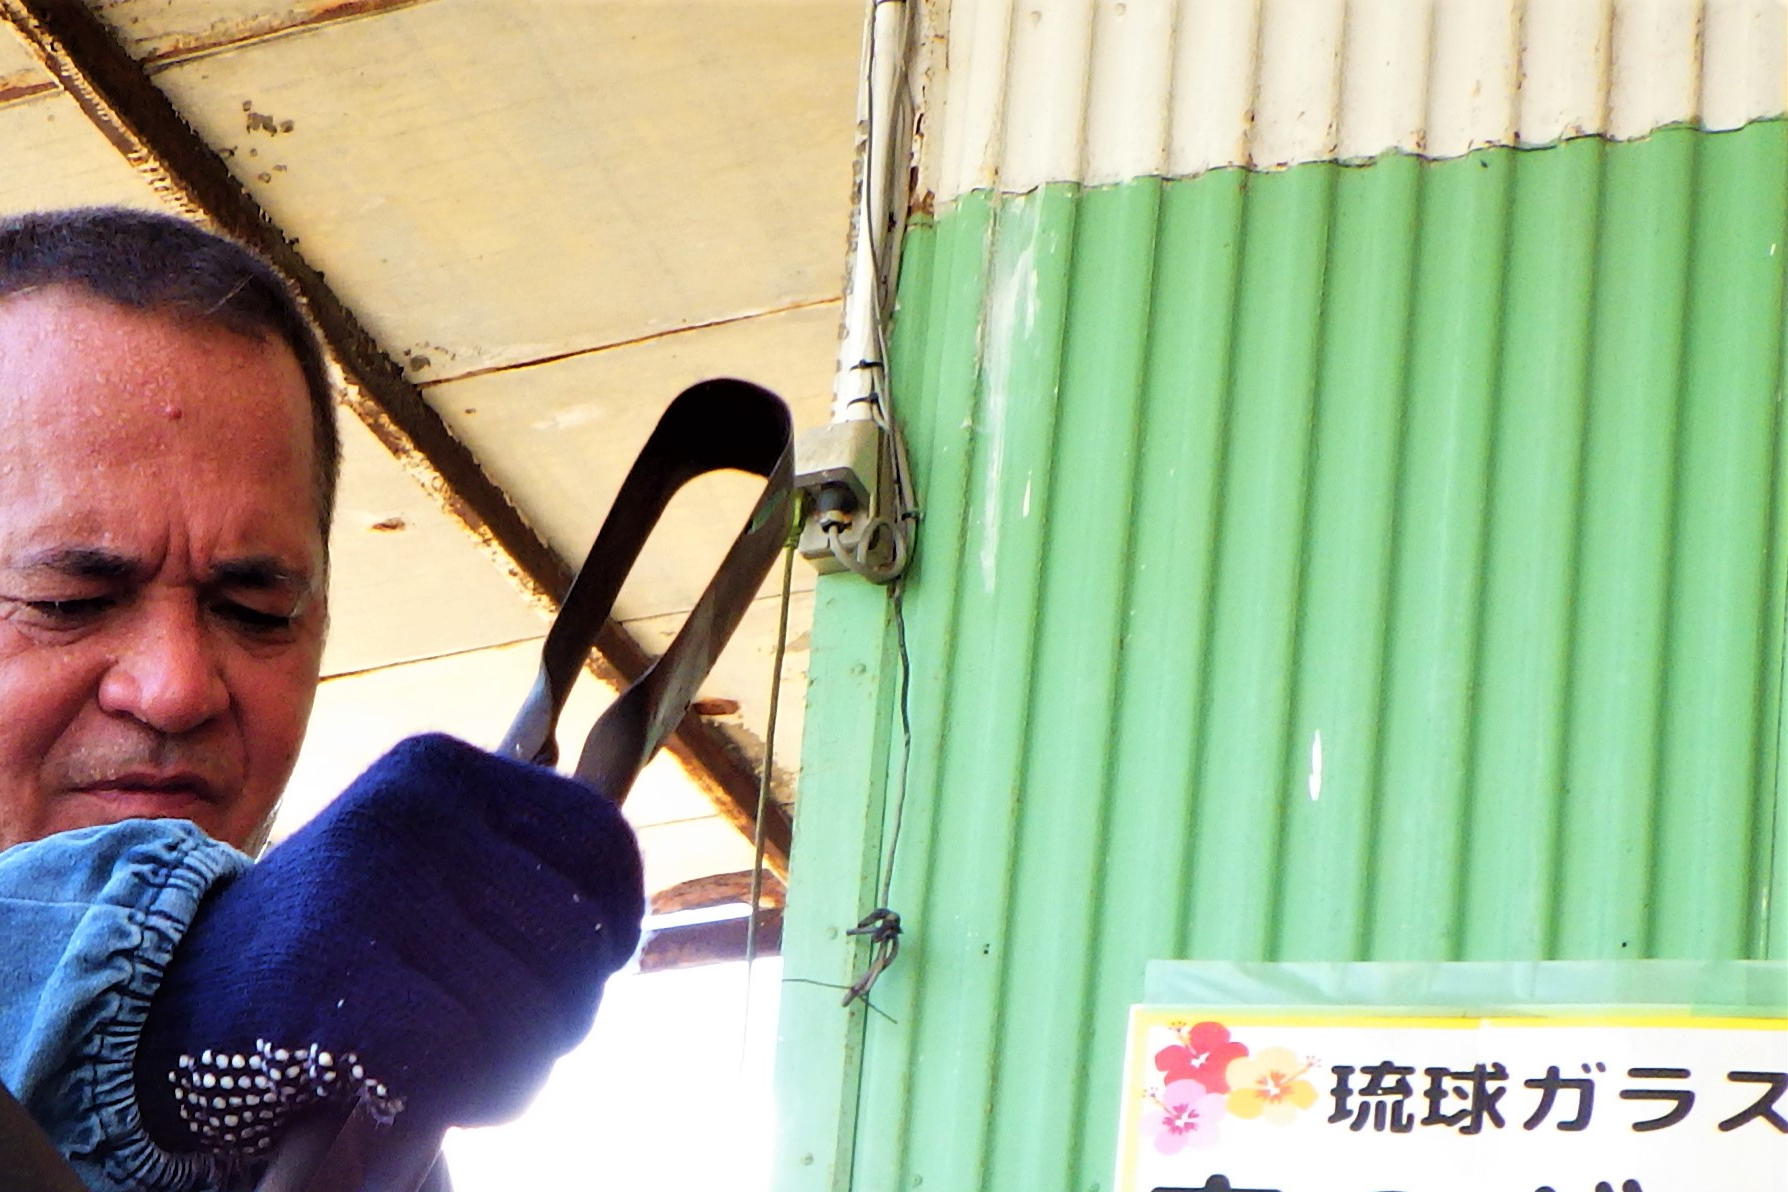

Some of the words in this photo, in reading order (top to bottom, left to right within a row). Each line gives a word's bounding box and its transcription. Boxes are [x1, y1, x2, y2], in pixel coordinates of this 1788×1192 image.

[1328, 1060, 1788, 1135] 琉球ガラス
